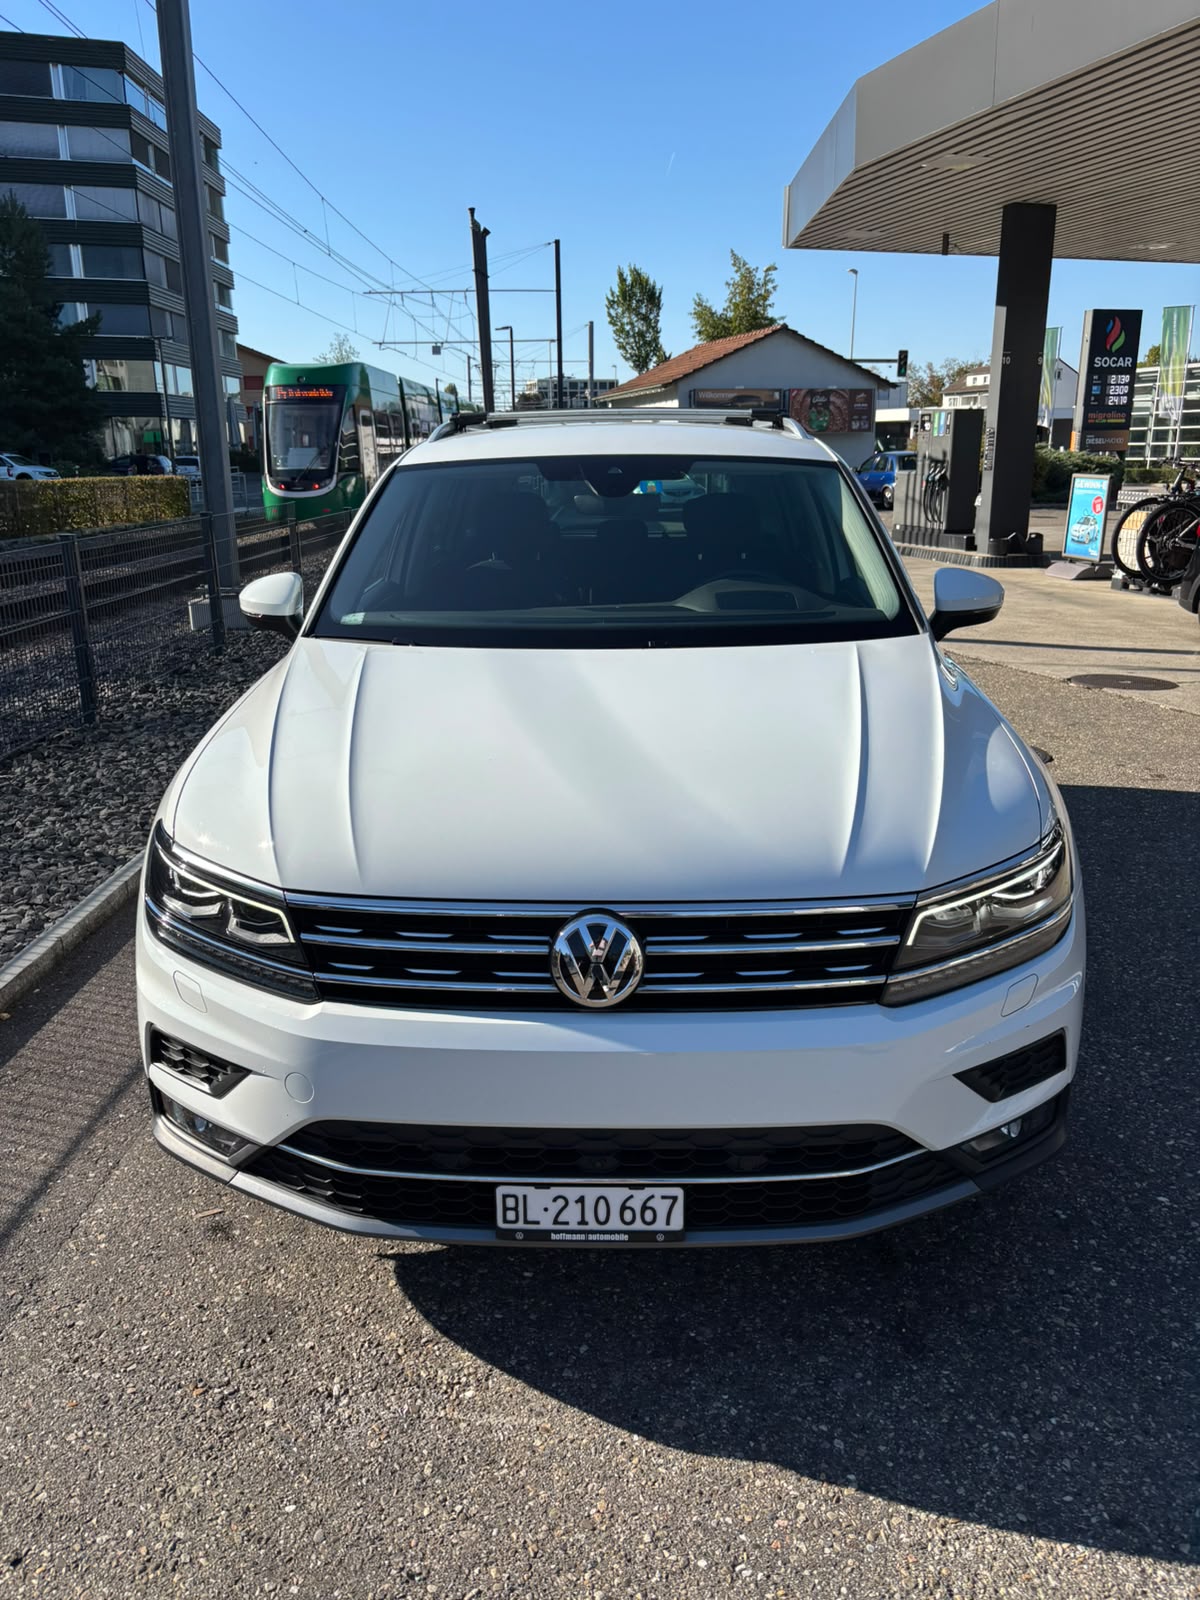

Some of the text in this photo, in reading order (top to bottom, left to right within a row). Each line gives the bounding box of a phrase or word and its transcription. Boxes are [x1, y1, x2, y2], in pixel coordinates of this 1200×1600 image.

[1094, 356, 1132, 368] SOCAR
[551, 1232, 629, 1241] hoffmann automobile
